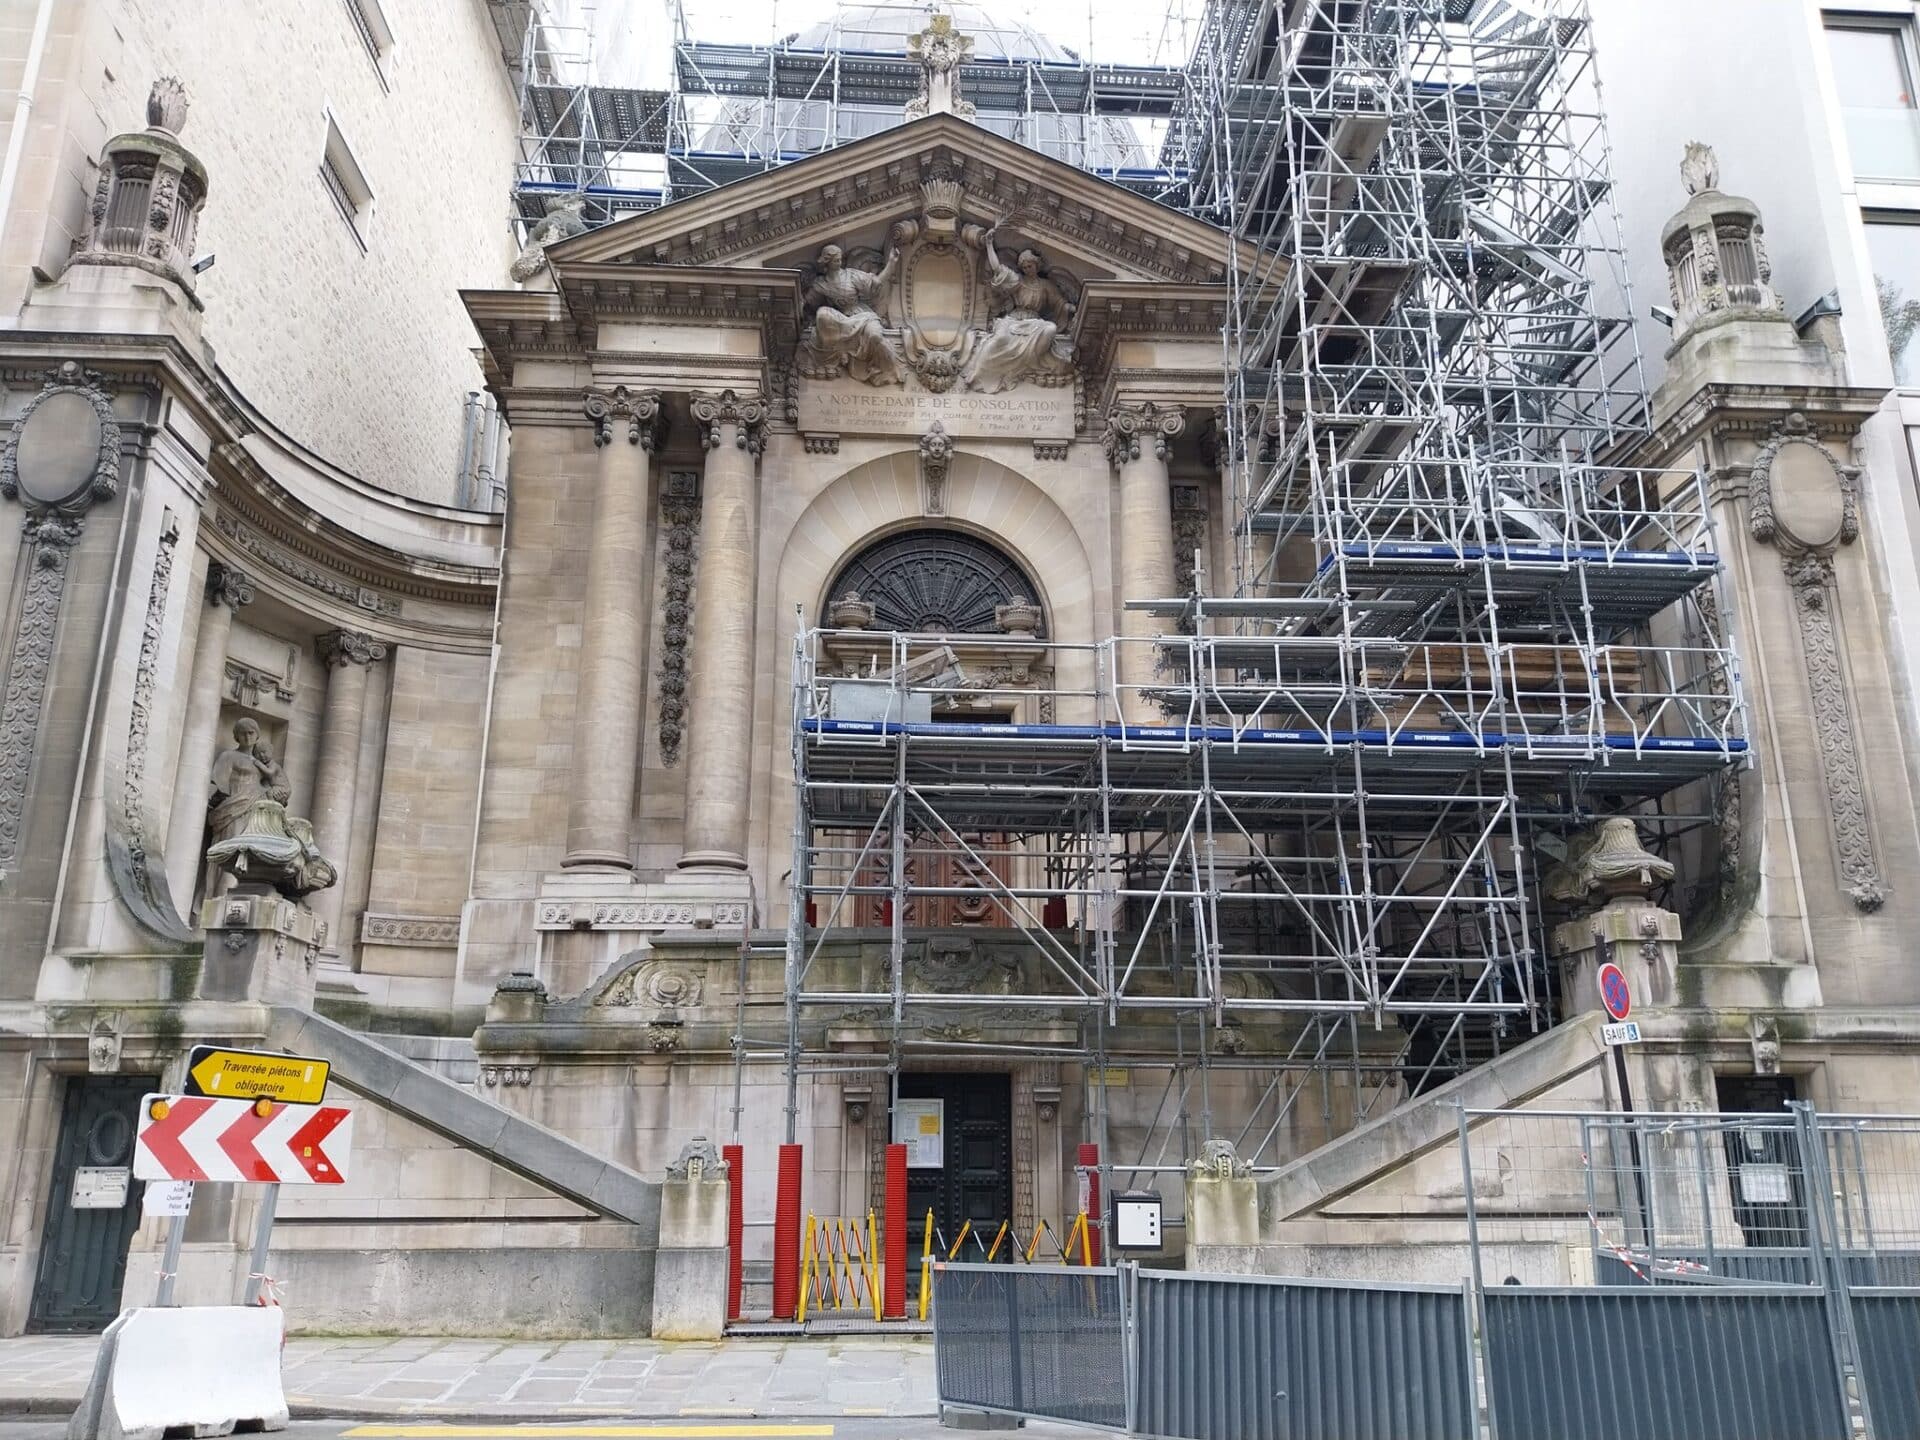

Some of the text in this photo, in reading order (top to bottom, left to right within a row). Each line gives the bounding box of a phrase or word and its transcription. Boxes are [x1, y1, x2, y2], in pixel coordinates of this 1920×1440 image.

[831, 395, 927, 408] NOTRE-DAME
[932, 398, 950, 408] DE
[959, 399, 1060, 411] CONSOLATION
[1606, 1027, 1625, 1040] SAUF
[223, 1060, 301, 1077] Traversée piétons
[235, 1080, 285, 1094] obligatoire
